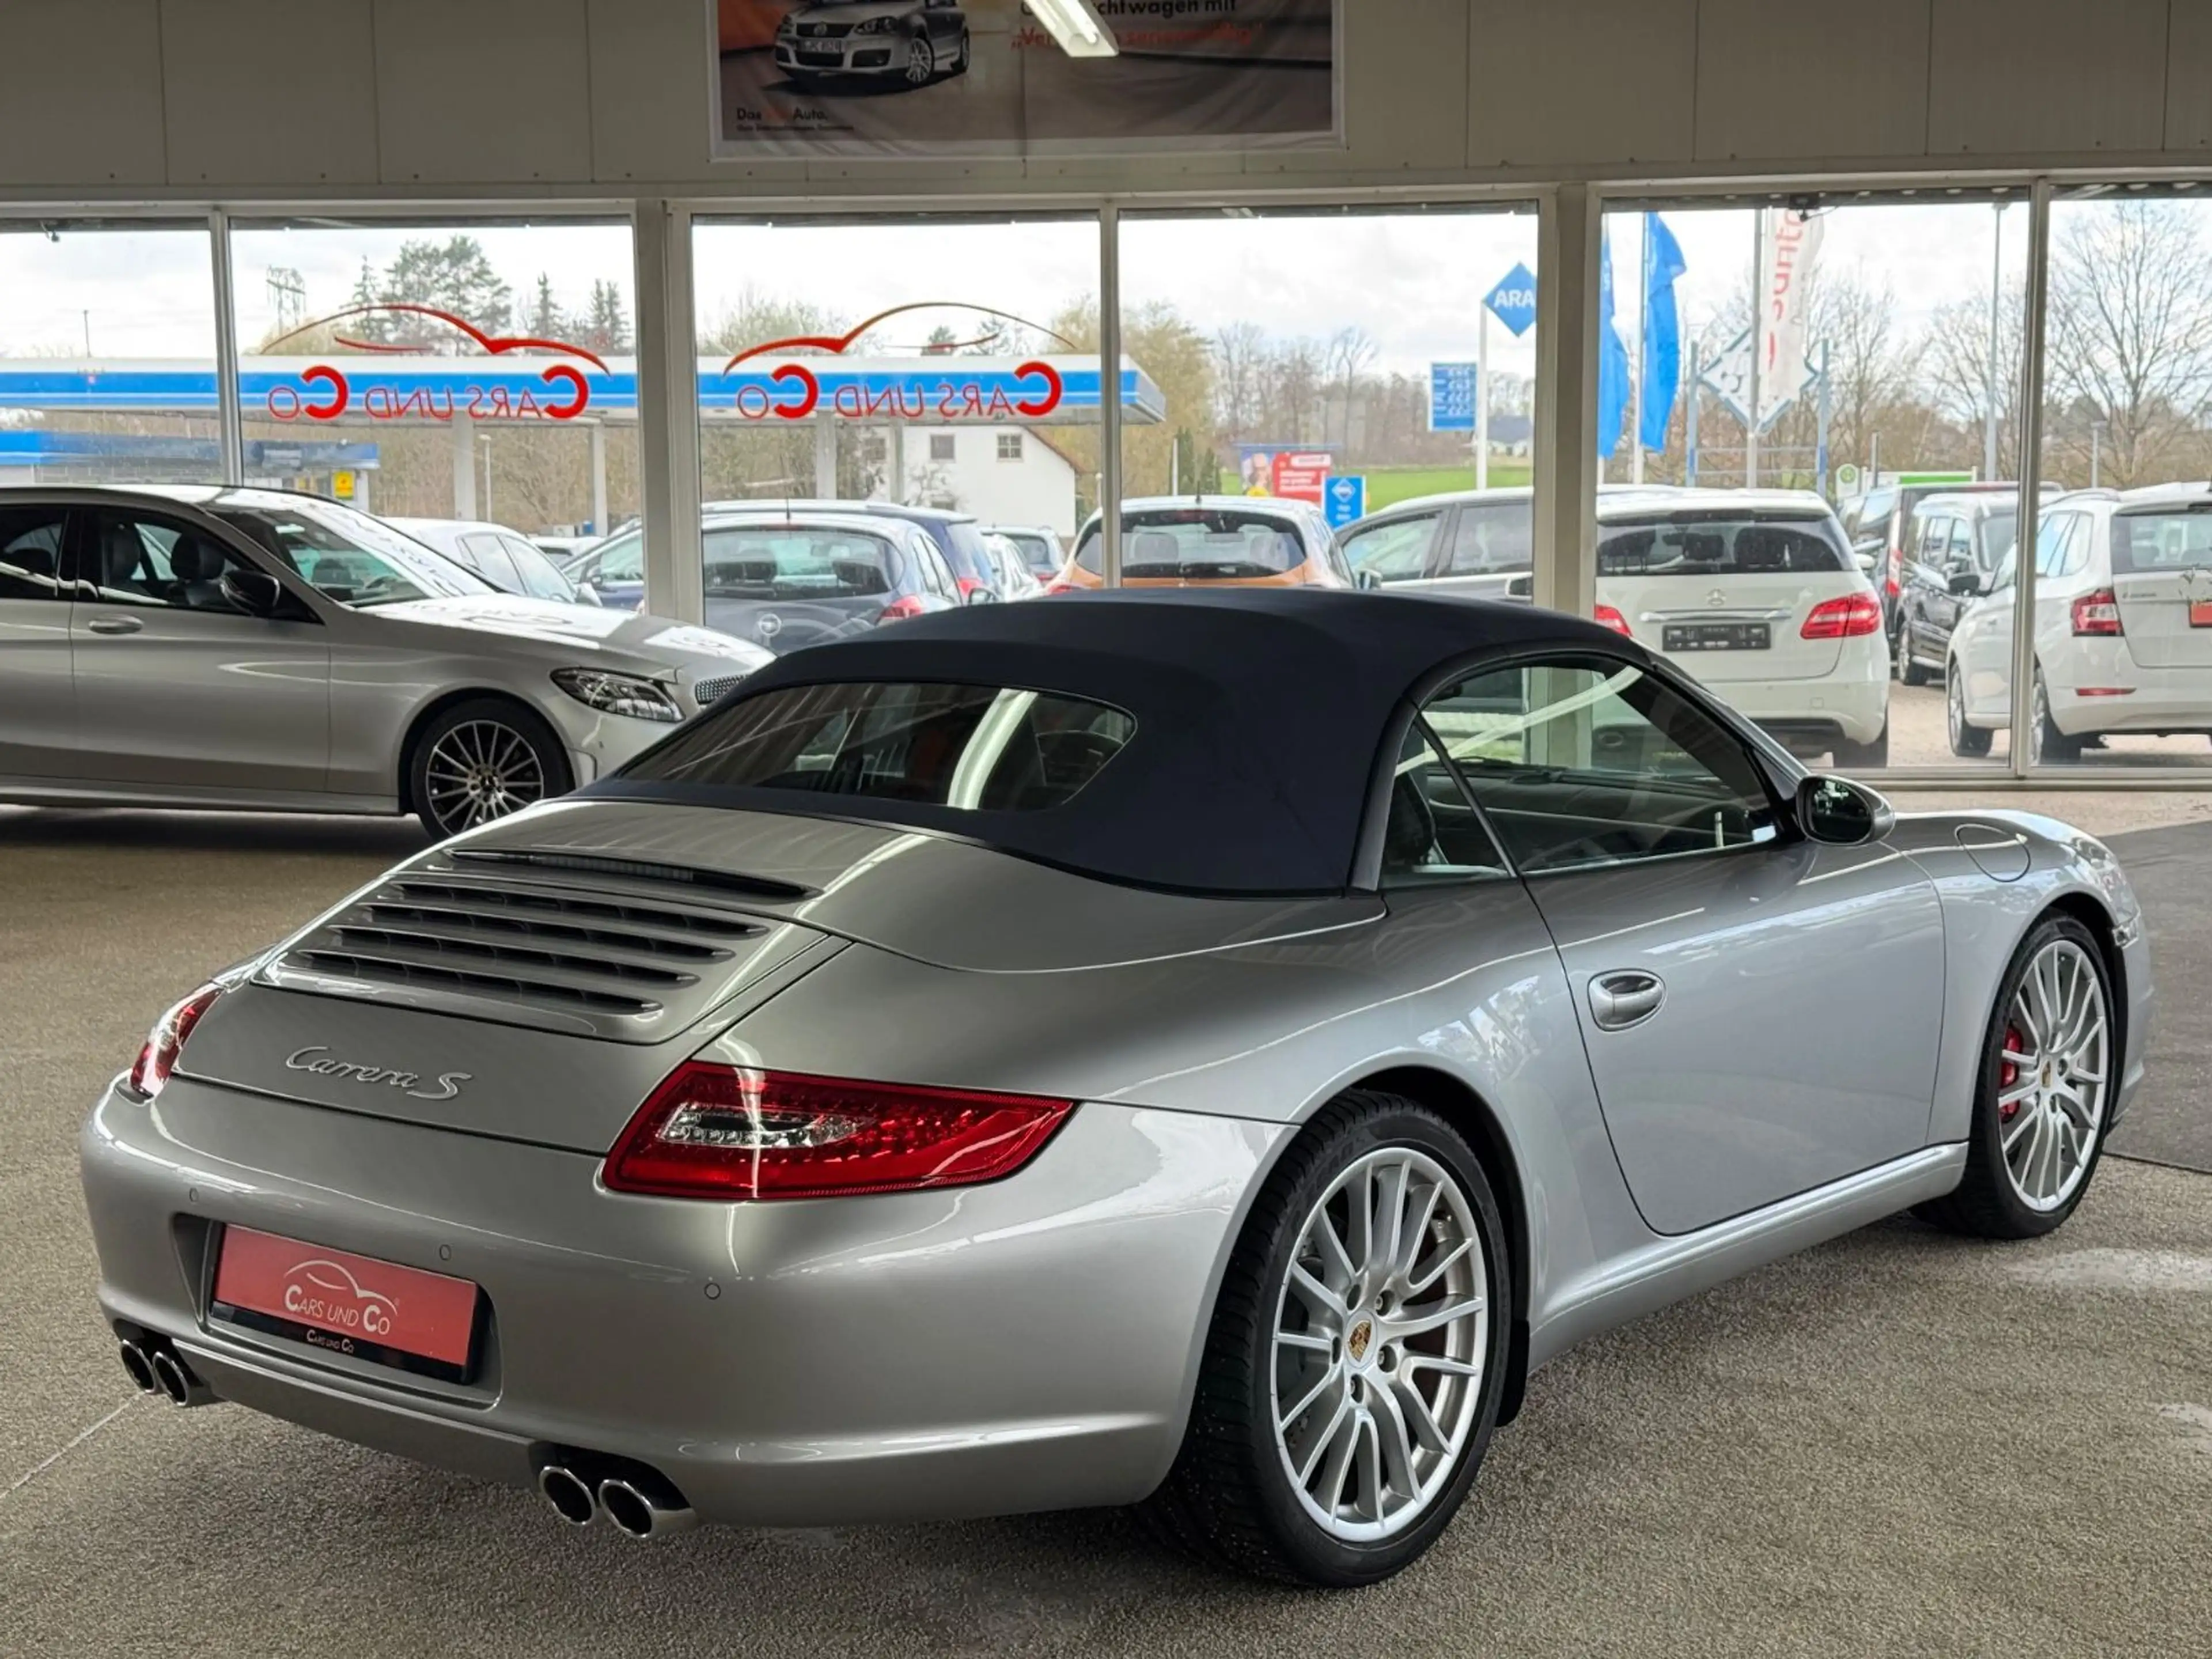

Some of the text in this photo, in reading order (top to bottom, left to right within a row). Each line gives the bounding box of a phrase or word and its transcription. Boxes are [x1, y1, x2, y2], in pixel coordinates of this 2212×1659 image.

[736, 108, 762, 120] Das
[1494, 289, 1535, 309] ARA
[285, 1046, 472, 1100] Carrera S
[285, 1284, 391, 1335] CARS UND CO
